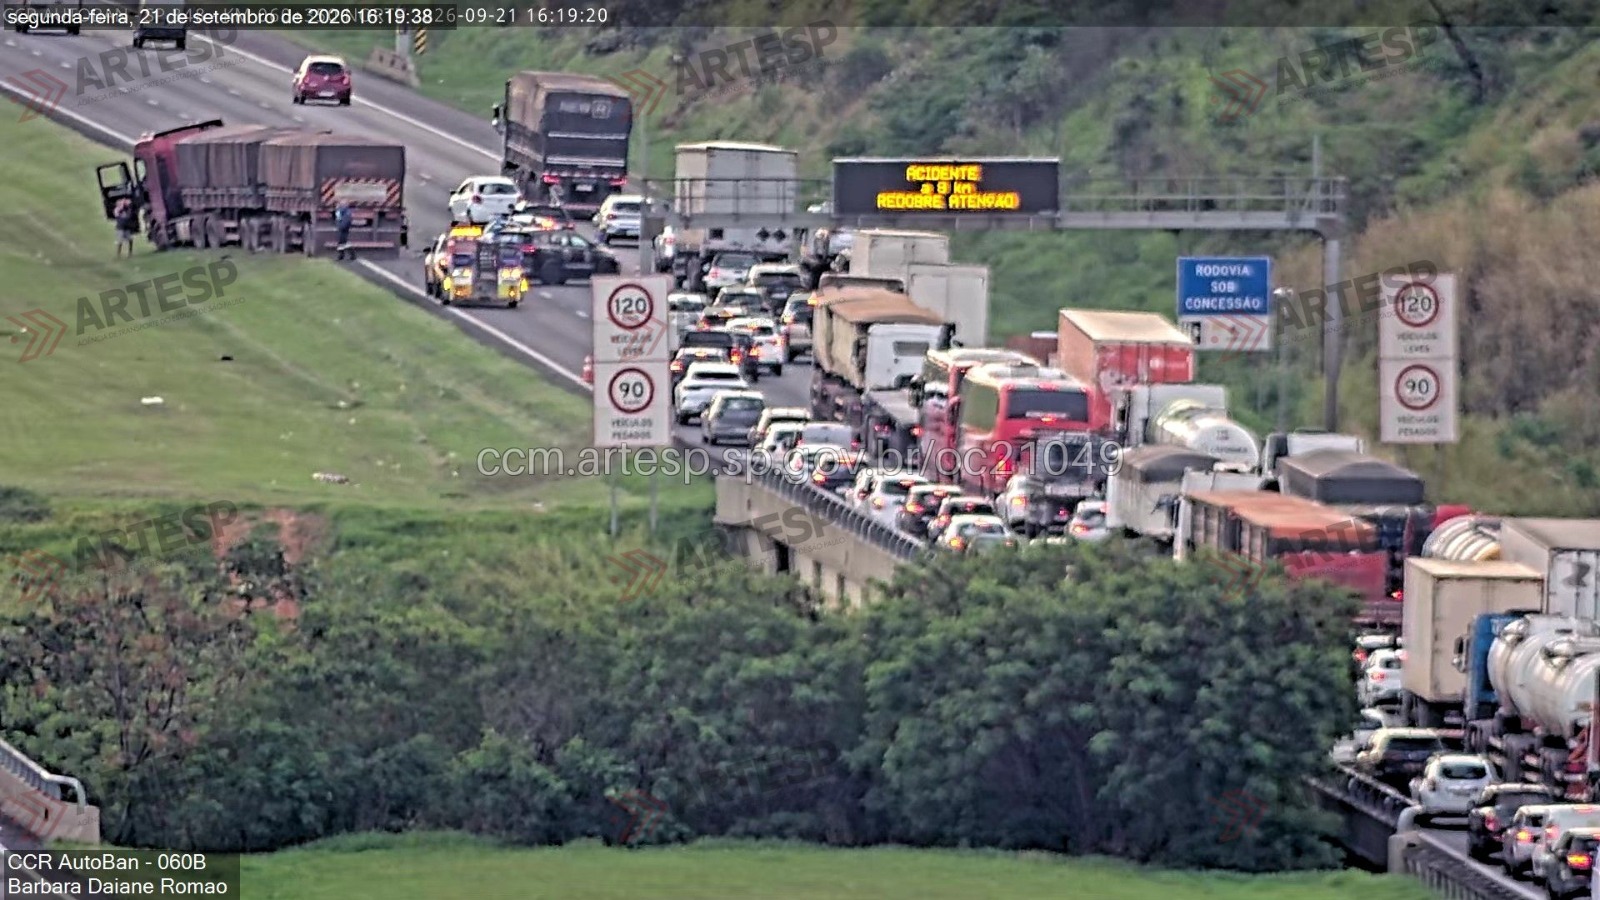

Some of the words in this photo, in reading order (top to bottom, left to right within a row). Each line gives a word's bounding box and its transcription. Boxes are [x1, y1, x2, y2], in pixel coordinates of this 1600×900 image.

[906, 164, 982, 181] ACIDENTE
[953, 181, 976, 194] km
[876, 192, 946, 209] REDOBRE
[1195, 264, 1250, 276] RODOVIA
[1210, 281, 1235, 293] SOB
[614, 297, 647, 315] 120
[1185, 294, 1261, 310] CONCESSÃO
[1399, 296, 1432, 314] 120
[618, 381, 644, 399] 90
[1405, 378, 1430, 395] 90
[611, 430, 653, 440] PESADOS
[1398, 427, 1438, 436] PESADOS
